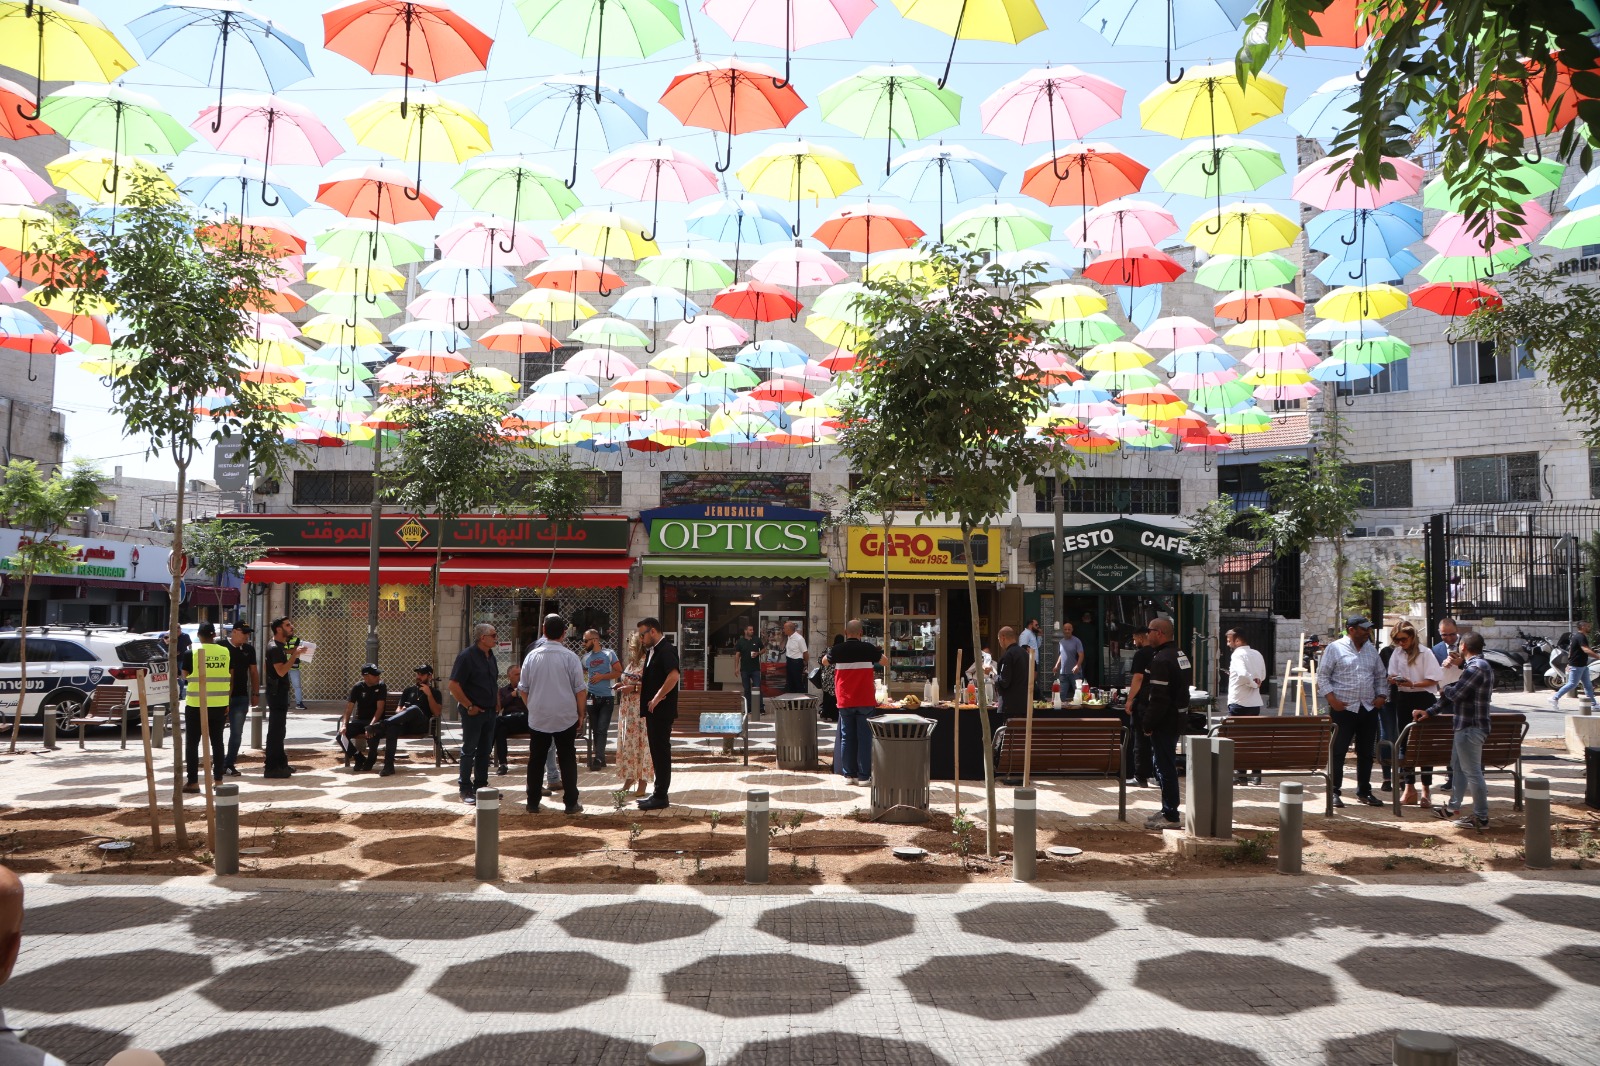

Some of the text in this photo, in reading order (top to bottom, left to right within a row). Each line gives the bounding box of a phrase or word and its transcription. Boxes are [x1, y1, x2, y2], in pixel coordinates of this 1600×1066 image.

[1558, 257, 1600, 274] JERUS
[704, 505, 764, 517] JERUSALEM
[453, 521, 531, 546] البهارات
[659, 521, 808, 552] OPTICS
[1140, 531, 1191, 556] CAFE
[860, 533, 934, 557] GARO
[909, 554, 948, 565] Since 1952
[78, 566, 127, 578] RESTAURANT
